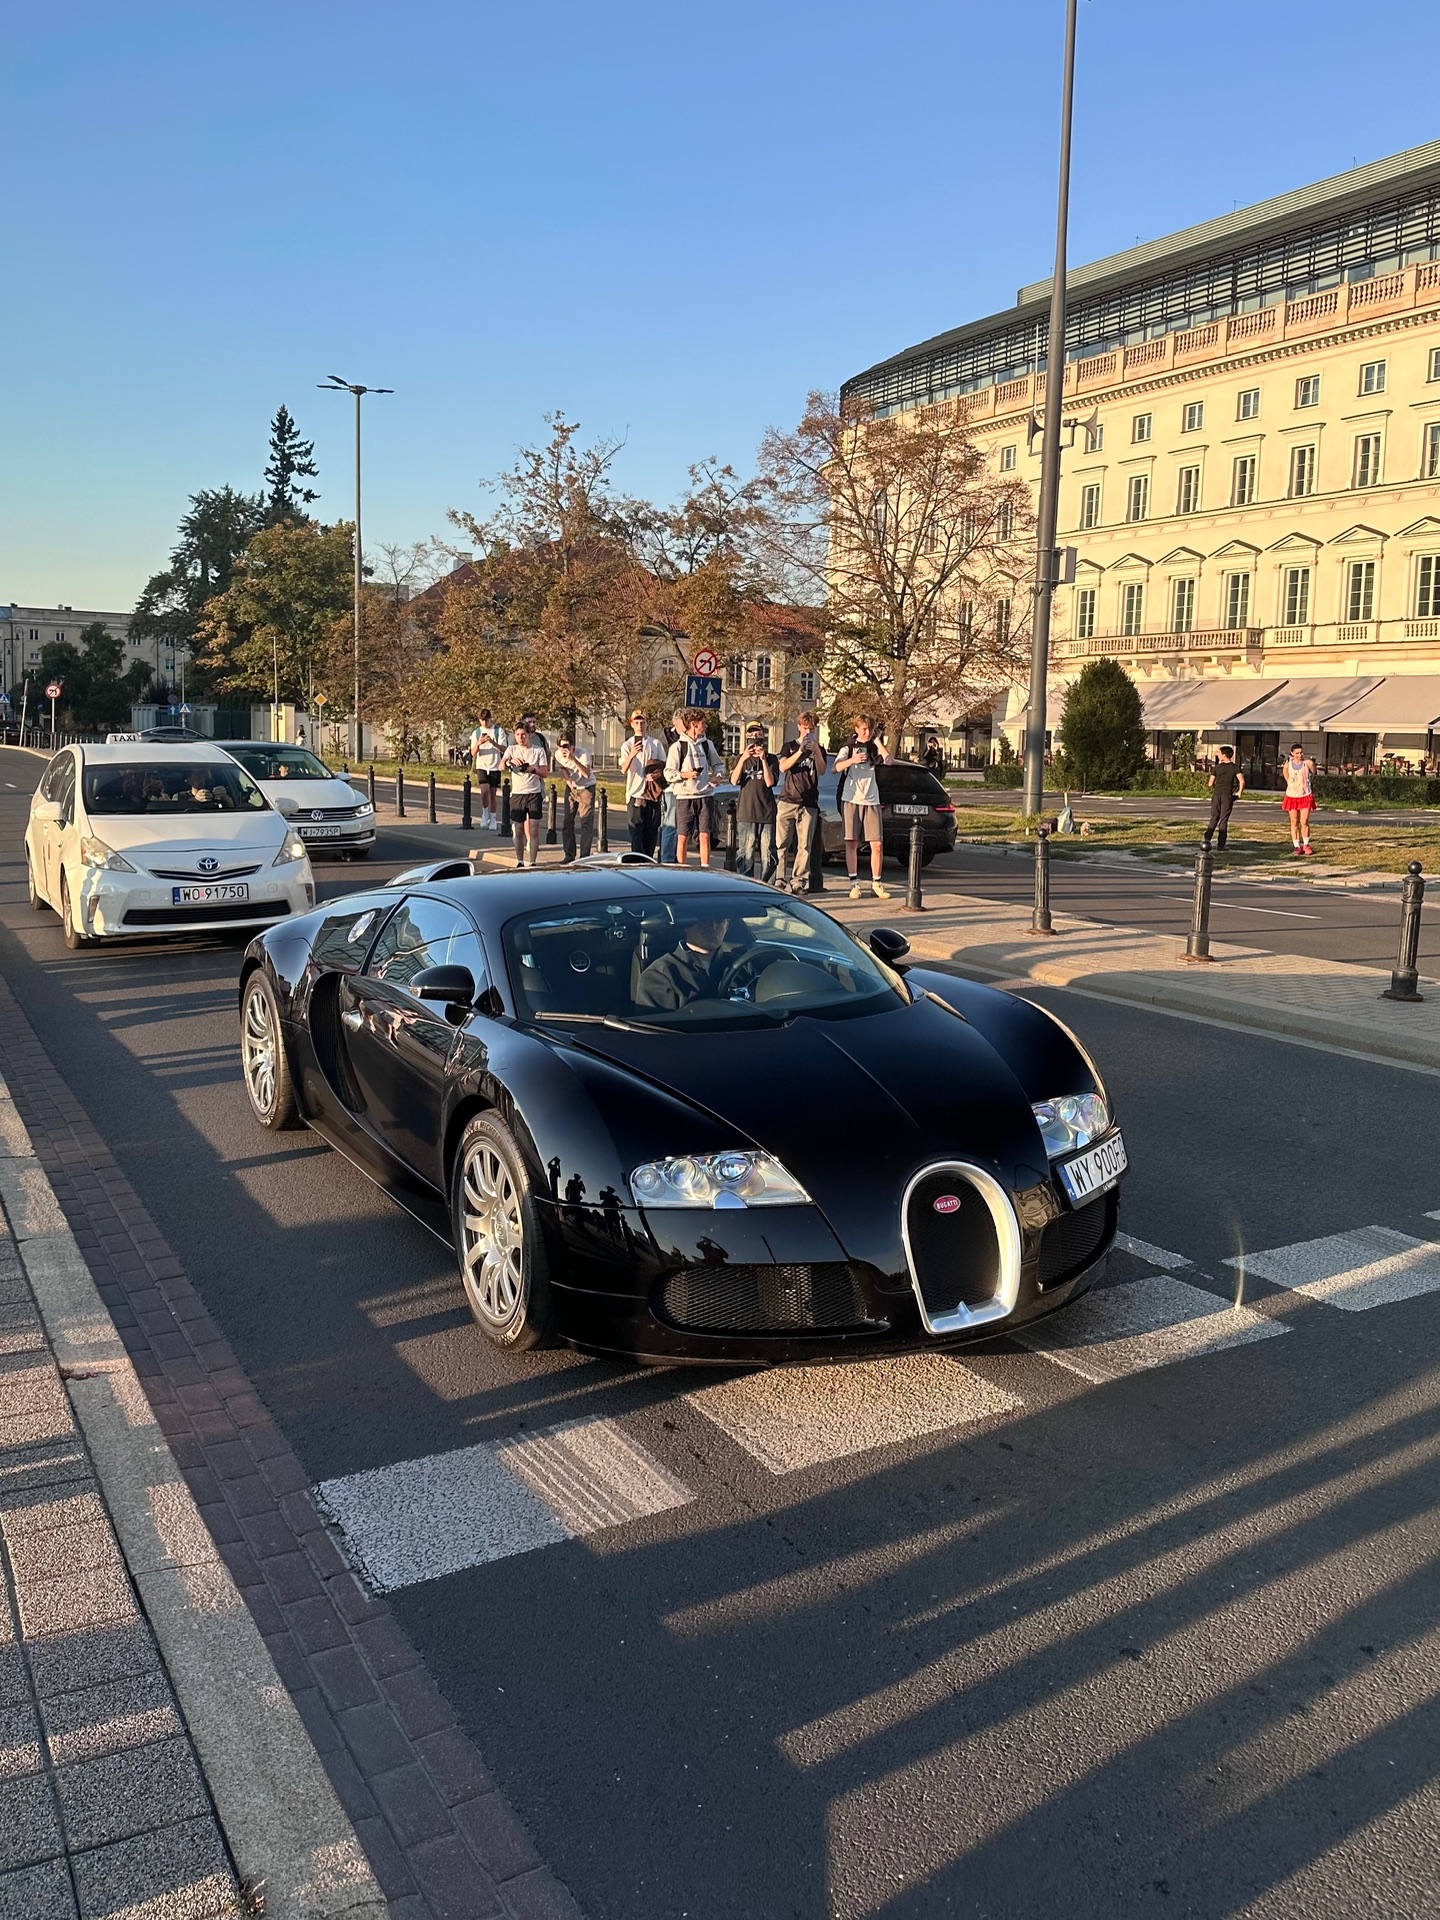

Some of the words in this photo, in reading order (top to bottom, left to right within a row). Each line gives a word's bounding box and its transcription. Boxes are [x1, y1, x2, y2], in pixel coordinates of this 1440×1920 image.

[111, 734, 136, 742] TAXI
[183, 888, 201, 901] WO
[205, 885, 245, 900] 91750
[1069, 1158, 1094, 1194] WY
[936, 1199, 958, 1210] BUGATTI
